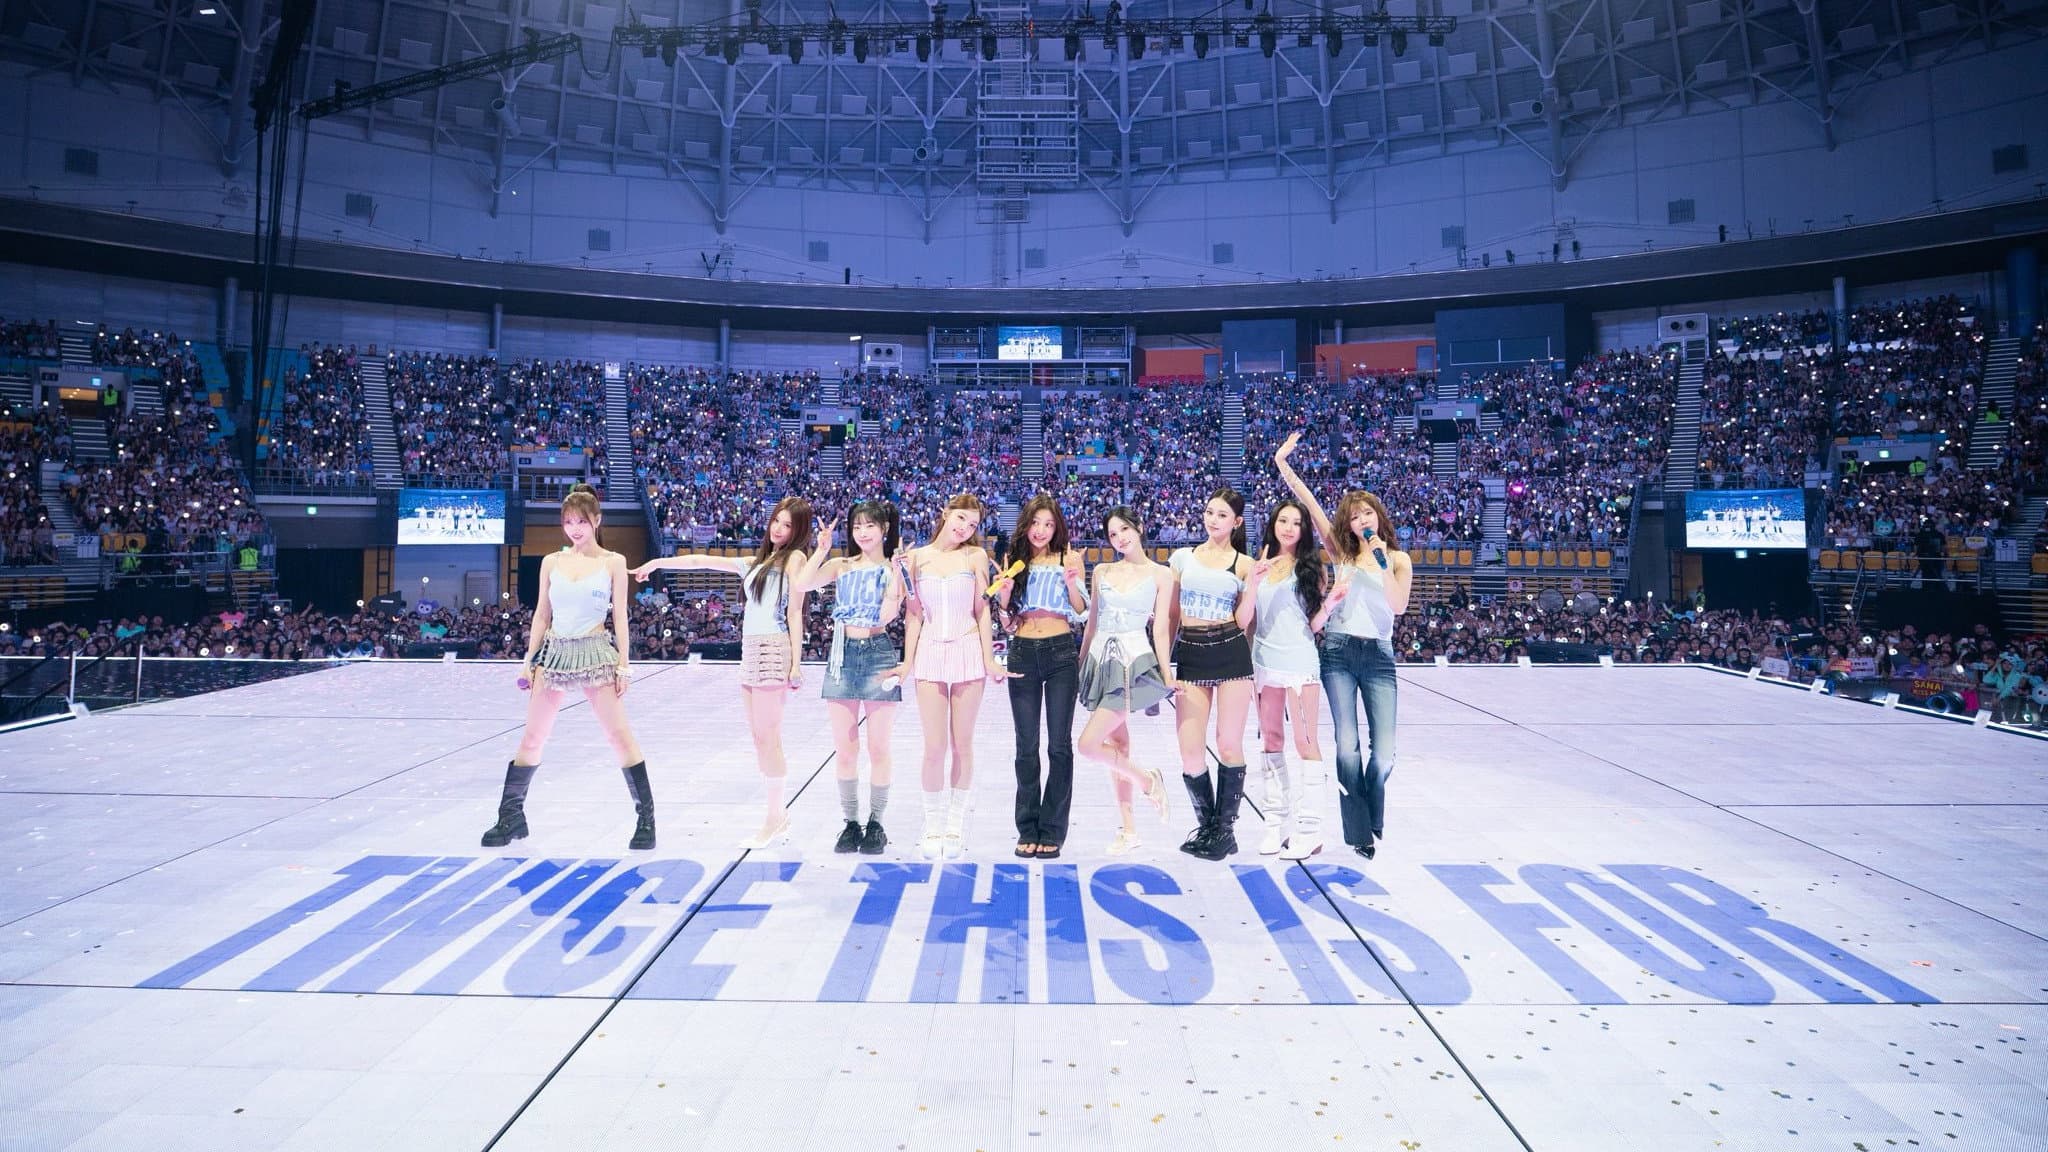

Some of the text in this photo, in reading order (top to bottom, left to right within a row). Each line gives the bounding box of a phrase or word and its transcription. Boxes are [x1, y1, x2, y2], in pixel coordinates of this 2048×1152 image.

[2001, 540, 2009, 549] 5
[133, 855, 1943, 1006] TWICE THIS IS FOR
